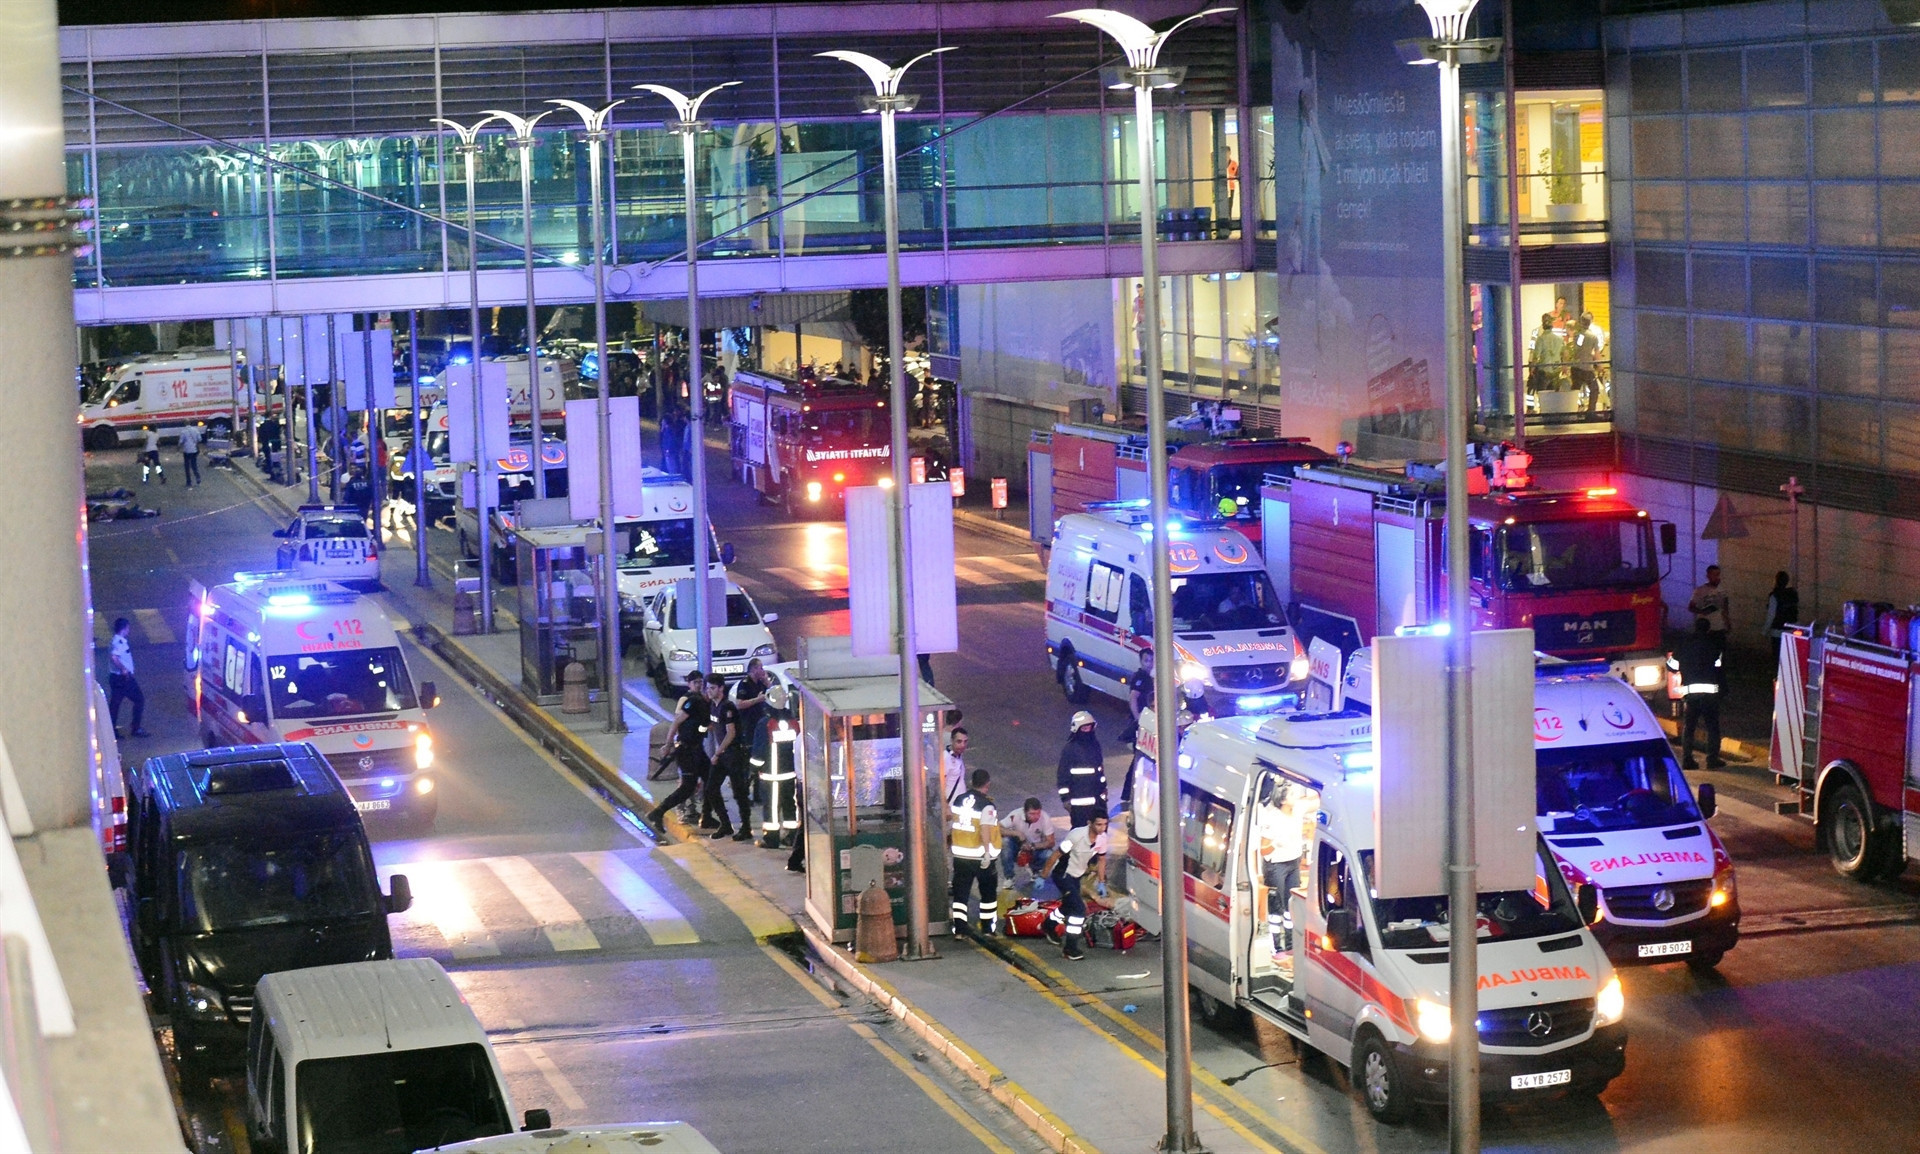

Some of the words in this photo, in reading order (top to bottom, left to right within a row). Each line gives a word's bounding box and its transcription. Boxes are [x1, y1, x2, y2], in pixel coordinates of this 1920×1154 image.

[1400, 125, 1437, 152] toplam
[1336, 164, 1342, 184] 1
[1343, 163, 1376, 189] milyon
[1378, 162, 1401, 189] uçak
[1403, 160, 1429, 184] bileti
[172, 380, 188, 398] 112
[419, 393, 438, 406] 112
[850, 448, 883, 459] İTFAİYE
[1332, 497, 1339, 526] 3
[1169, 548, 1198, 562] 112
[333, 618, 364, 637] 112
[1563, 619, 1608, 632] MAN
[302, 642, 335, 652] HIZIR
[270, 665, 287, 680] 112
[1534, 716, 1563, 732] 112
[1643, 945, 1655, 956] 34
[1656, 944, 1667, 954] YB
[1668, 942, 1690, 953] 5022
[1517, 1076, 1530, 1087] 34
[1532, 1074, 1545, 1086] YB
[1547, 1071, 1570, 1084] 2573
